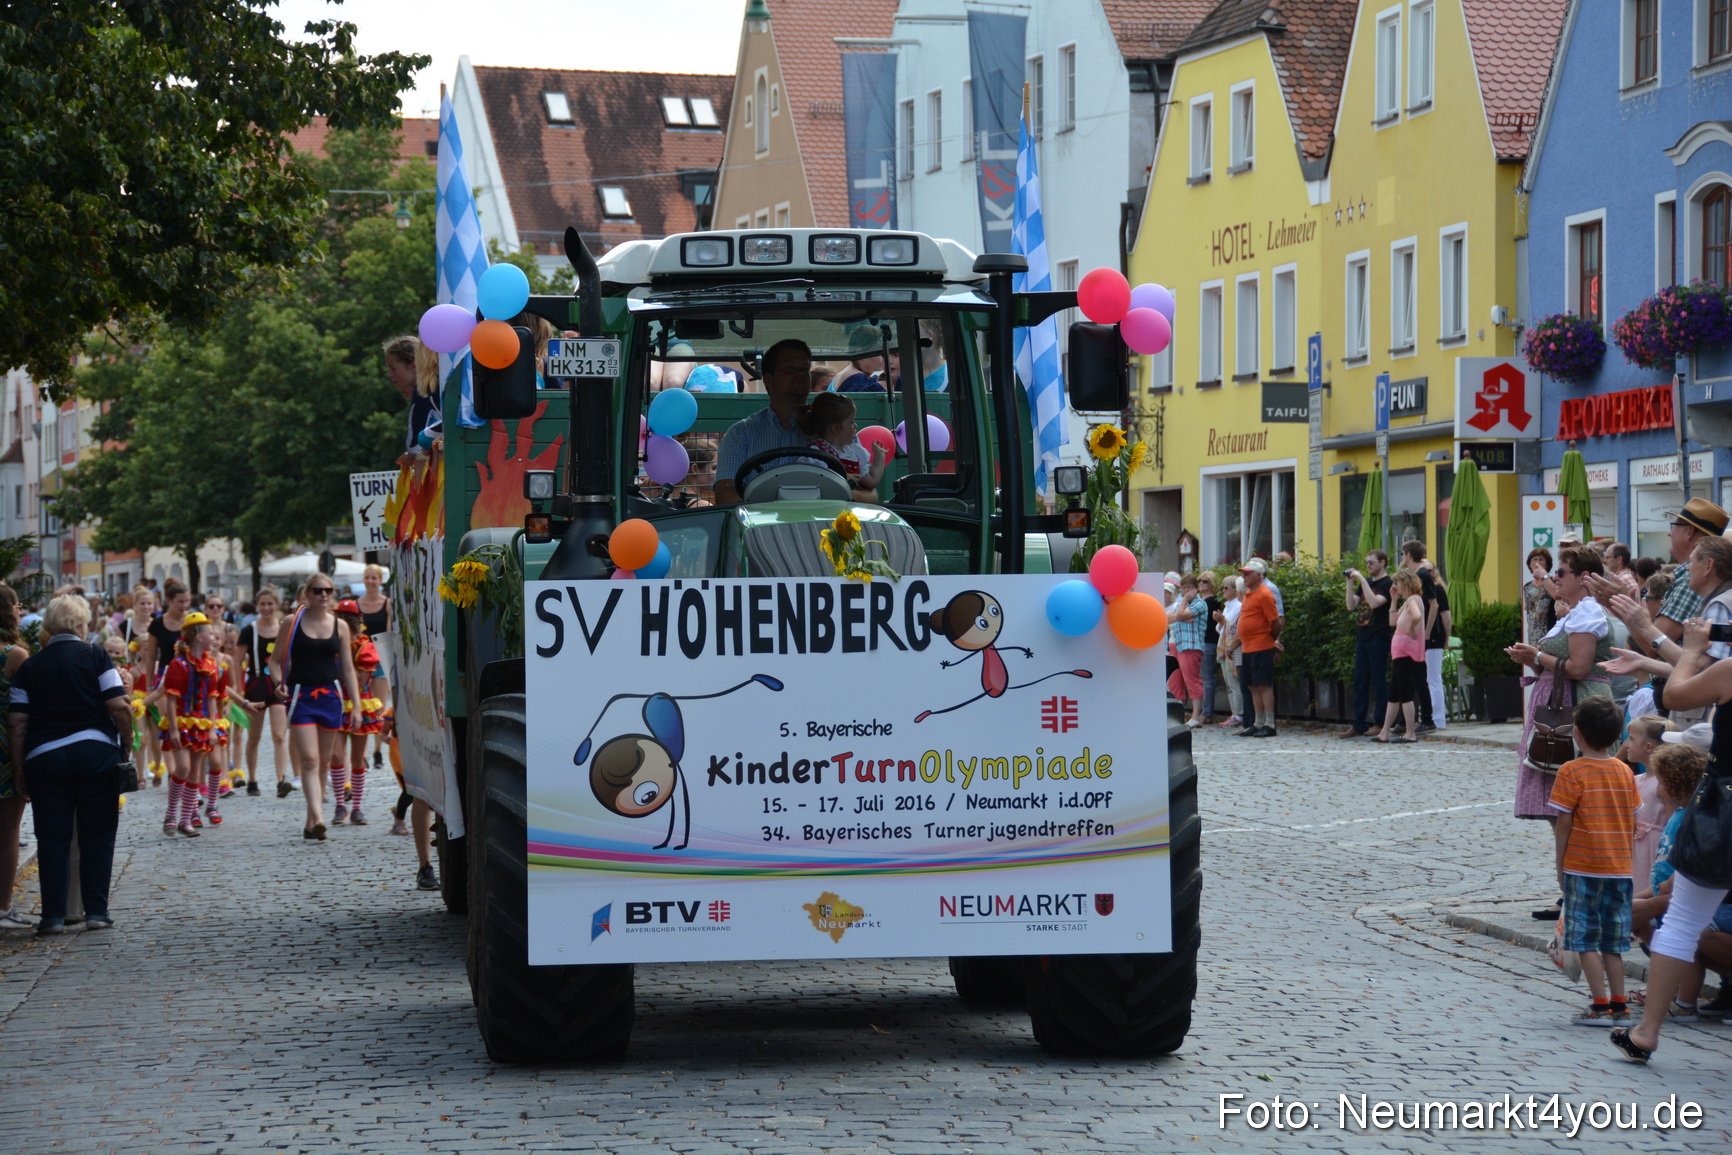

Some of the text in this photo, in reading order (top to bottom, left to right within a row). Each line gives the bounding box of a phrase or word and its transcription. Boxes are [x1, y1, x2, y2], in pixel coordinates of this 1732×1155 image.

[1211, 212, 1317, 267] HOTEL Lehmeier
[564, 342, 587, 358] NM
[1556, 384, 1674, 441] APOTHEKE
[1207, 426, 1269, 457] Restaurant
[1642, 463, 1670, 478] RATHAUS
[535, 586, 624, 658] SV
[640, 579, 931, 660] HÖHENBERG
[779, 718, 893, 742] 5. Bayerische
[706, 747, 1113, 790] KinderTurnOlympiade
[763, 797, 788, 814] 15.
[819, 796, 844, 814] 17.
[853, 794, 884, 815] Juli
[894, 794, 936, 811] 2016
[966, 791, 1048, 811] Neumarkt
[761, 819, 1115, 845] 34. Bayerisches Turnerjugendtreffen
[626, 901, 702, 924] BTV
[939, 893, 1087, 918] NEUMARKT
[625, 926, 676, 934] BAYERISCHER
[818, 918, 882, 929] Neumarkt
[1061, 923, 1088, 931] STADT
